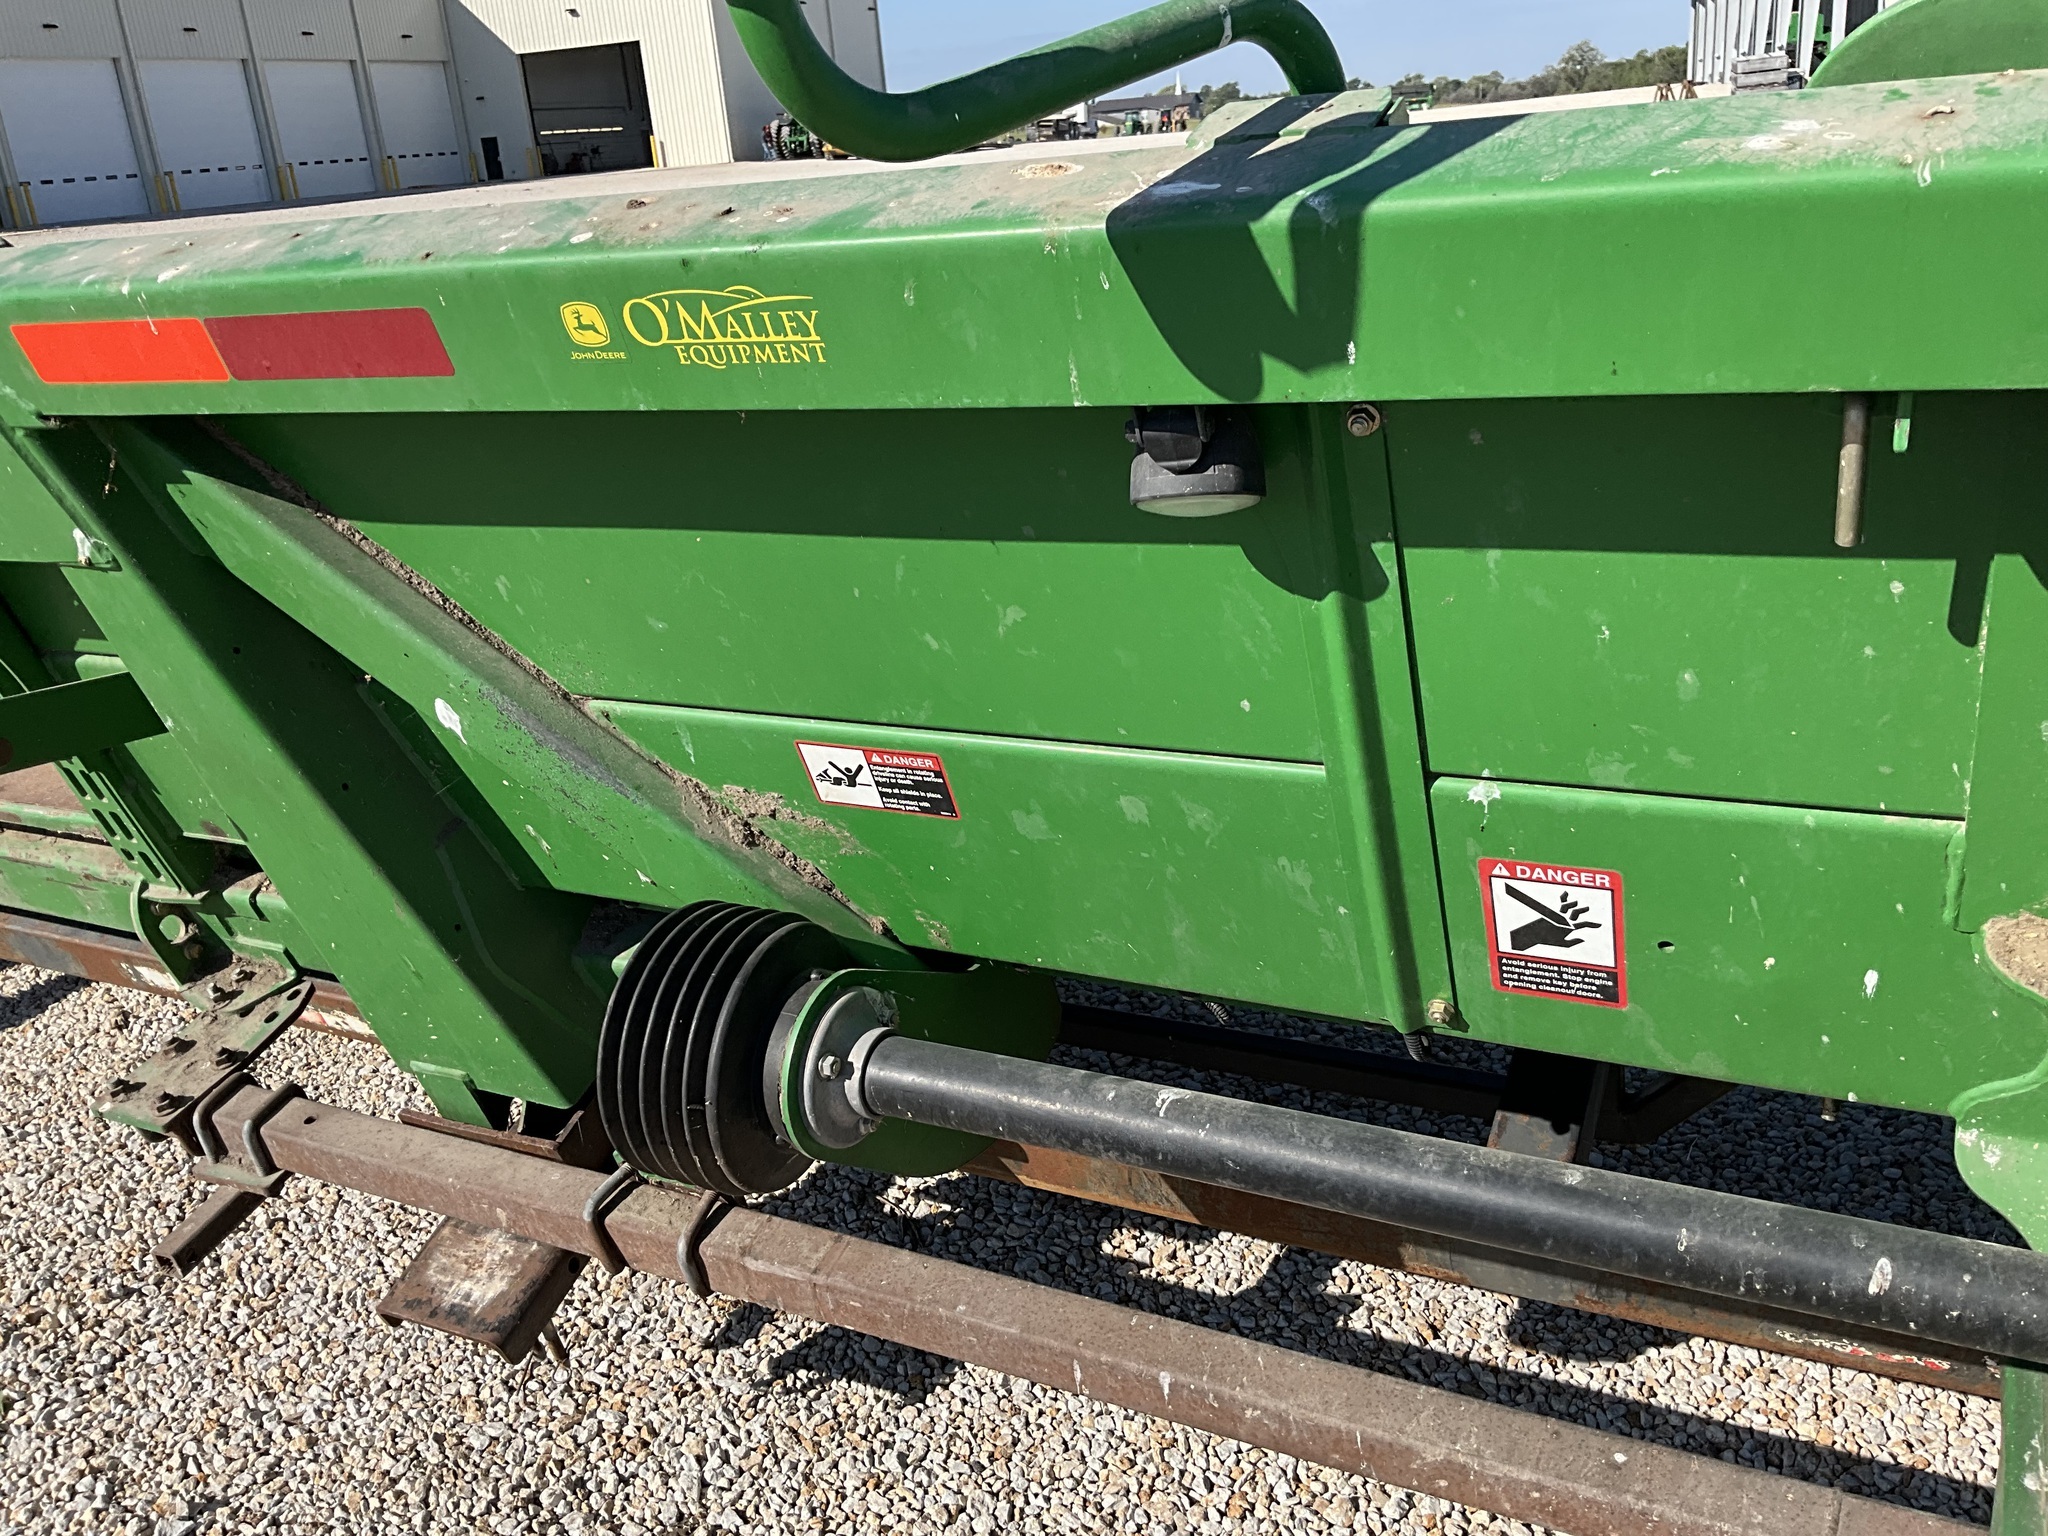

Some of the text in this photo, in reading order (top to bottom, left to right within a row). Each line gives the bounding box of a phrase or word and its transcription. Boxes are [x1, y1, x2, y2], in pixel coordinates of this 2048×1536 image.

[674, 343, 827, 369] EQUIPMENT
[883, 754, 934, 768] DANGER
[1515, 865, 1611, 888] DANGER
[1501, 958, 1608, 978] Avoid serious injury from
[1502, 966, 1613, 986] entanglement. Stop engine
[1503, 979, 1604, 999] opening cleanout doors.
[1520, 975, 1551, 984] remove
[1552, 978, 1568, 987] key
[1569, 981, 1597, 991] before
